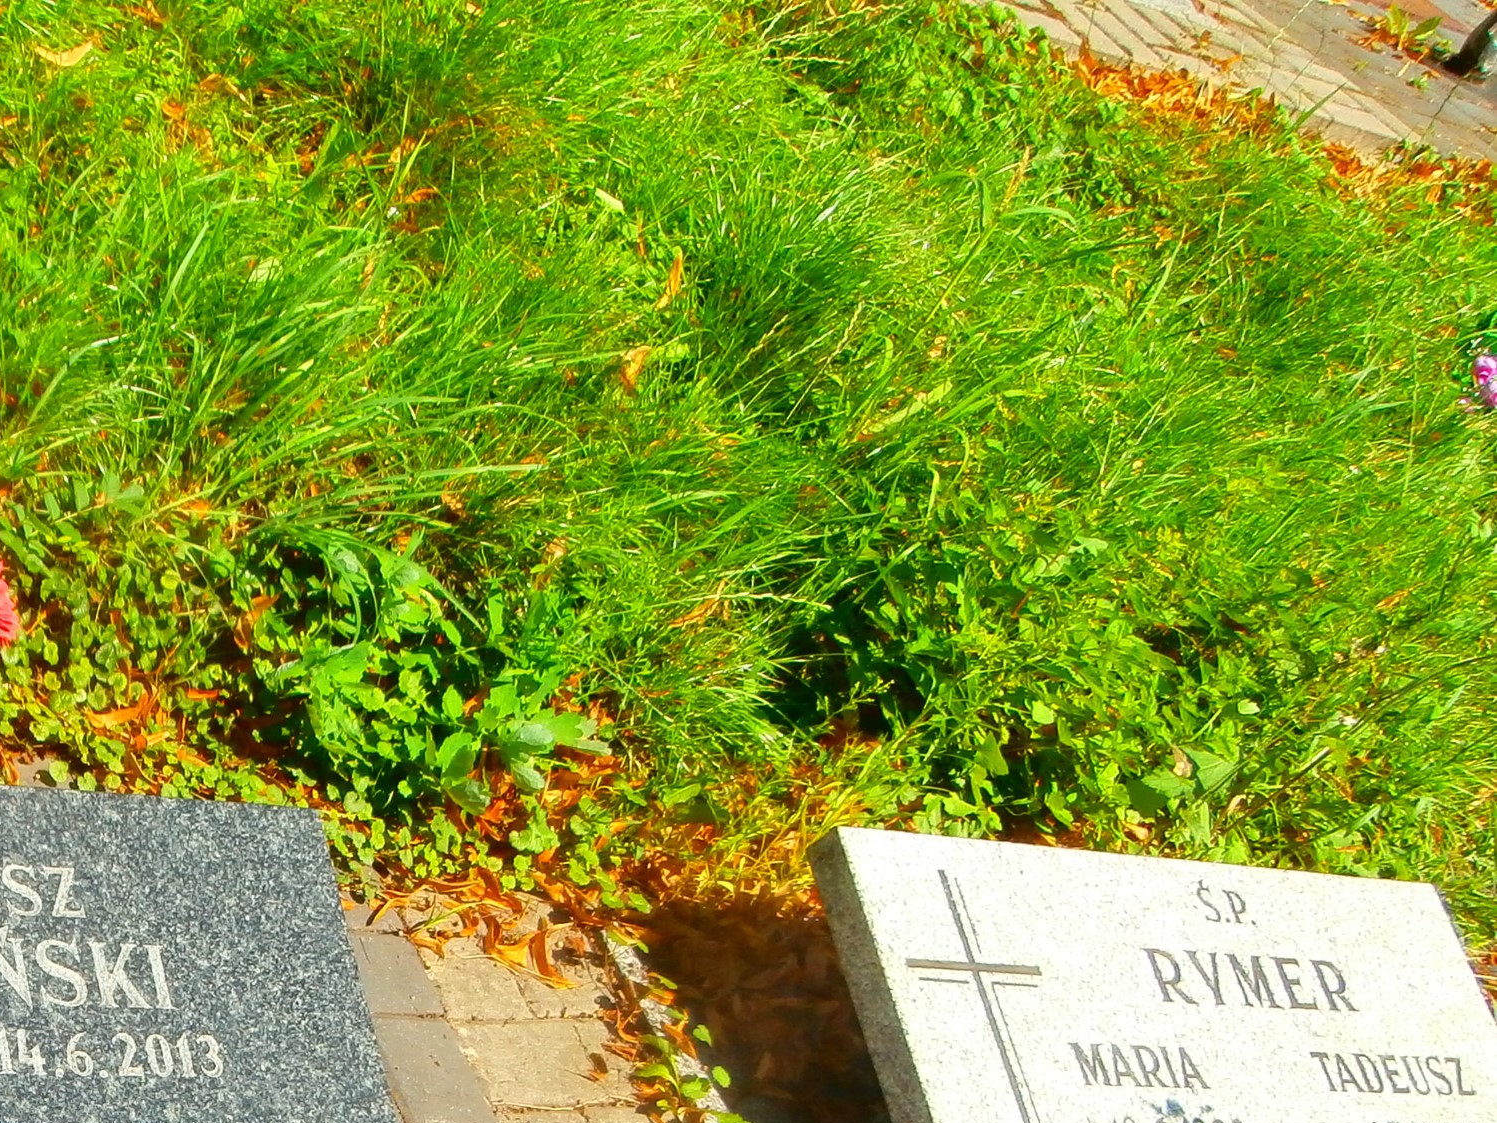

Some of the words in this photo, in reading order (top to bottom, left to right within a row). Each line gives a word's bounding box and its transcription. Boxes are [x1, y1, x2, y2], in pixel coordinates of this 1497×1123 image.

[1142, 947, 1359, 1012] RYMER
[1068, 1042, 1211, 1090] MARIA
[1309, 1051, 1476, 1096] TADEUSZ
